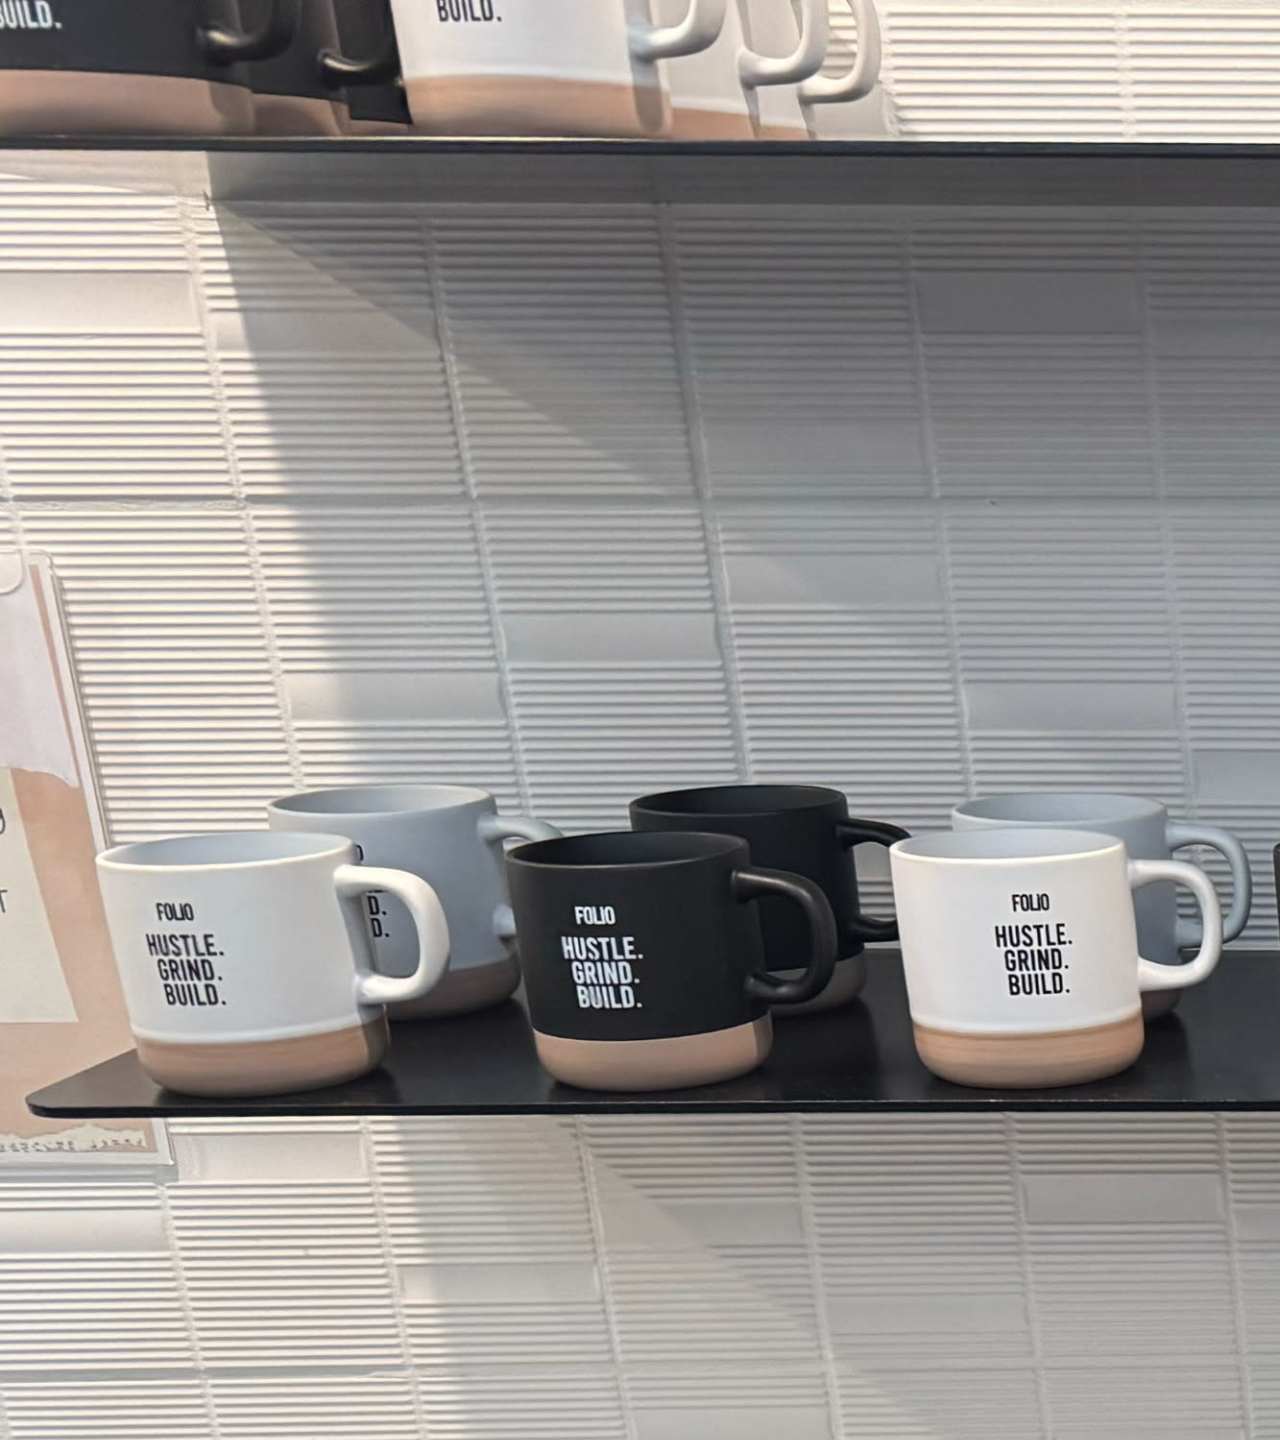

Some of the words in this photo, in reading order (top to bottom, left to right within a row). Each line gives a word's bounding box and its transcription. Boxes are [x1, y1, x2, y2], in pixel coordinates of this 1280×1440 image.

[437, 0, 502, 22] BUILD.
[156, 902, 194, 922] FOLIO
[1011, 894, 1050, 912] FOLIO
[575, 906, 616, 925] FOLIO
[146, 933, 225, 958] HUSTLE.
[995, 923, 1073, 948] HUSTLE.
[562, 937, 643, 961] HUSTLE.
[1005, 947, 1069, 971] GRIND.
[157, 958, 223, 982] GRIND.
[572, 961, 640, 984] GRIND.
[164, 983, 226, 1006] BUILD.
[1009, 971, 1070, 996] BUILD.
[578, 984, 642, 1009] BUILD.
